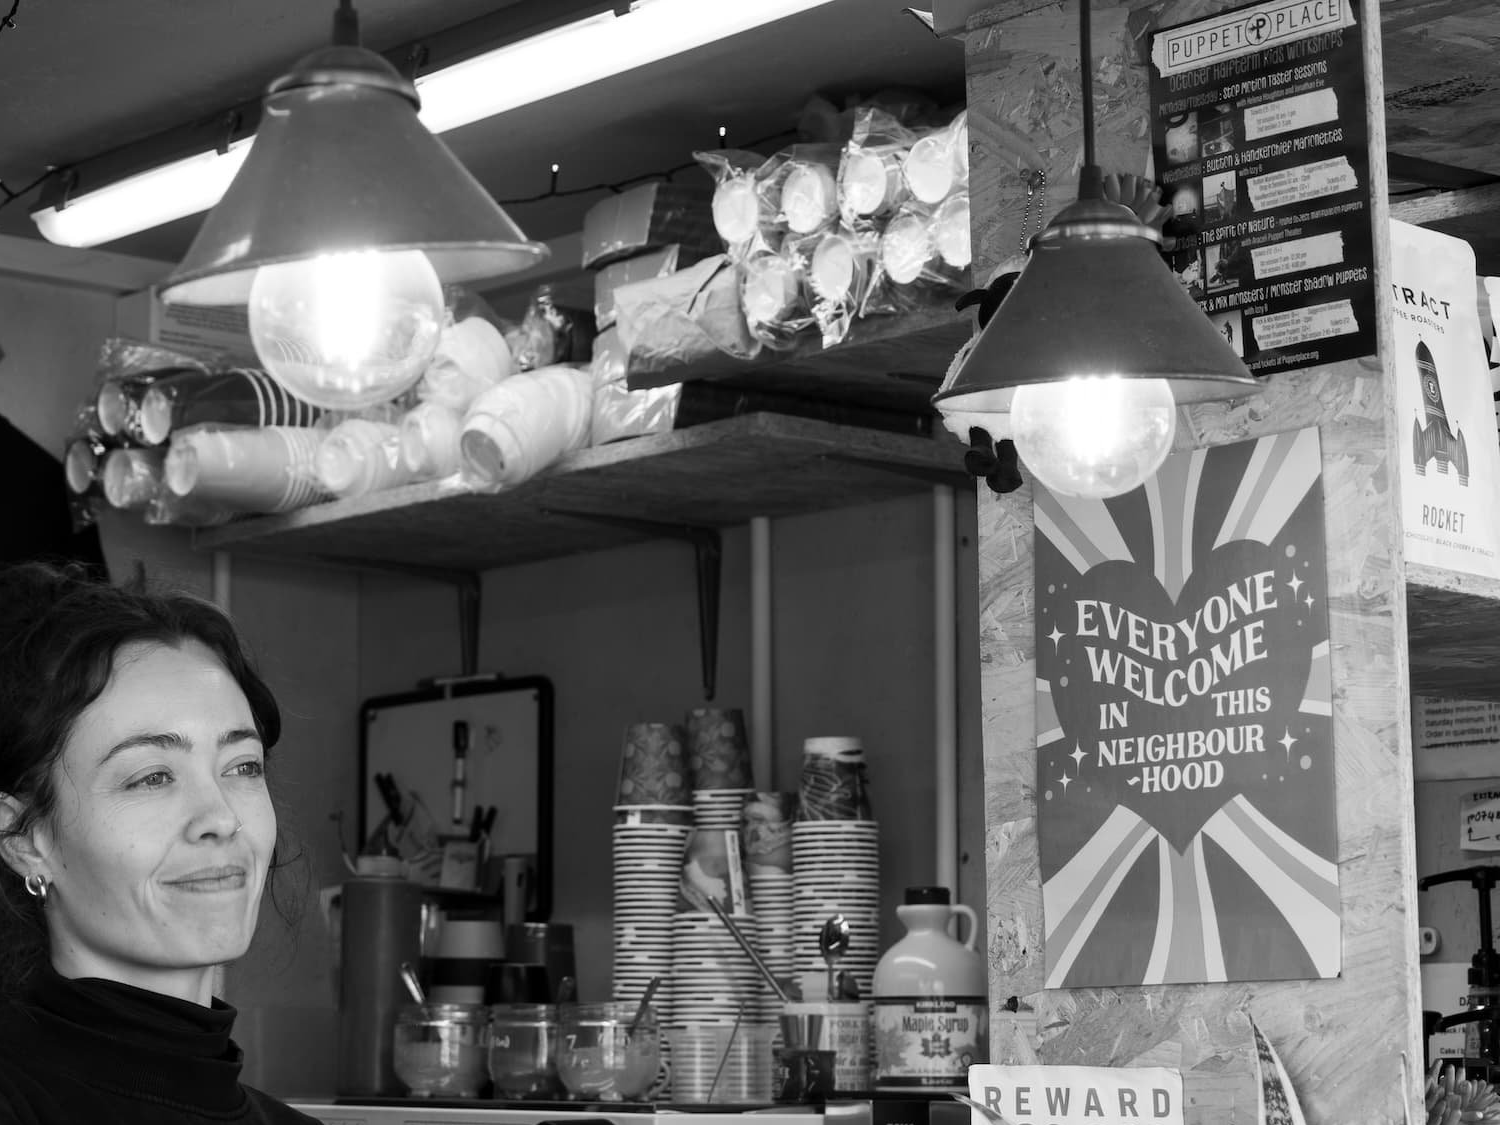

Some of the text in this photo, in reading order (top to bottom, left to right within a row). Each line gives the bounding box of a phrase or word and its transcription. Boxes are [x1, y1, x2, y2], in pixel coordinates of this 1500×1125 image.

[1171, 0, 1338, 61] PUPPET PLACE
[1422, 503, 1466, 535] ROCKET
[1074, 569, 1279, 662] EVERYONE
[1084, 619, 1268, 708] WELCOME
[1098, 686, 1273, 731] IN THIS
[1096, 724, 1266, 769] NEIGHBOUR
[901, 1015, 970, 1033] Maple Syrup
[984, 1086, 1171, 1119] REWARD
